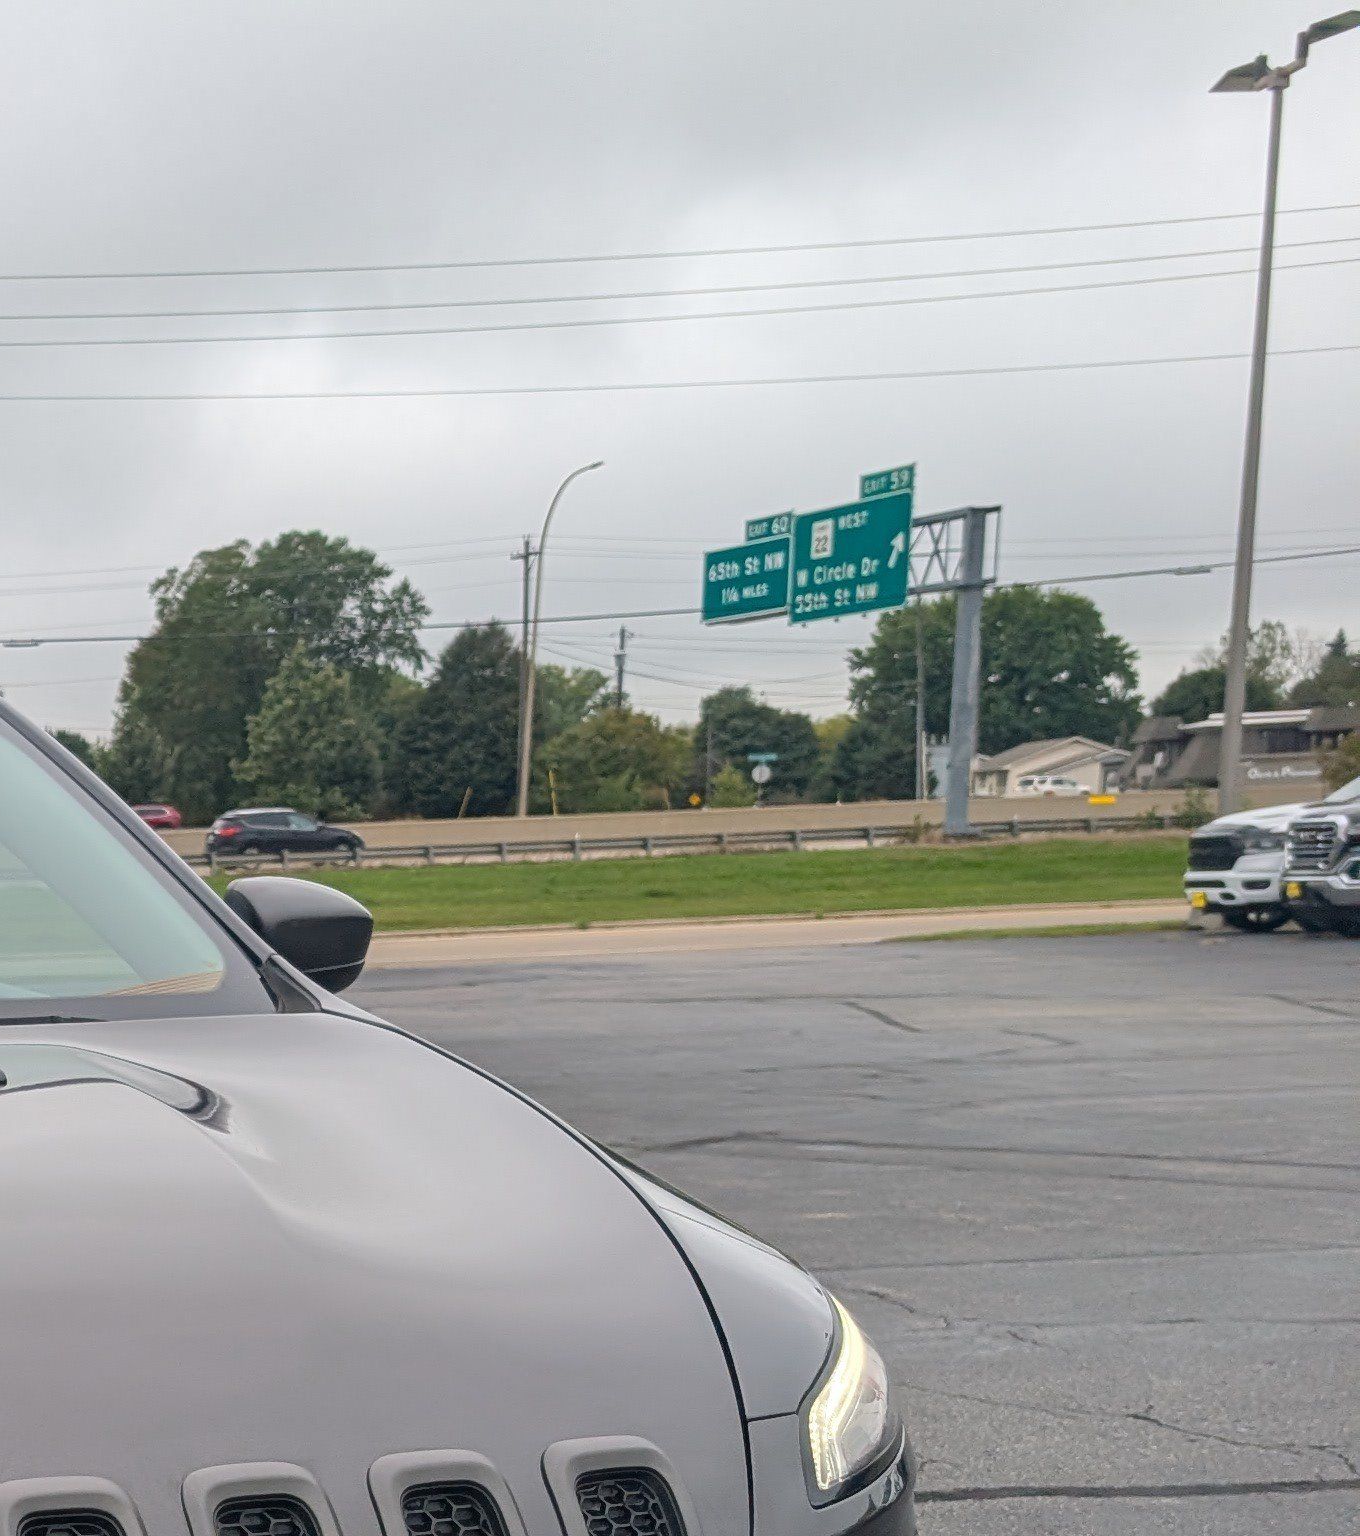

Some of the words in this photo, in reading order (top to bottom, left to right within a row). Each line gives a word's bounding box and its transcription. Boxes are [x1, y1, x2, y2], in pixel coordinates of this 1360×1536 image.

[744, 556, 760, 576] St
[764, 550, 785, 571] NW
[797, 568, 808, 588] W
[813, 562, 857, 585] Circle
[860, 556, 880, 577] Dr
[834, 588, 851, 607] St
[855, 582, 879, 604] NW
